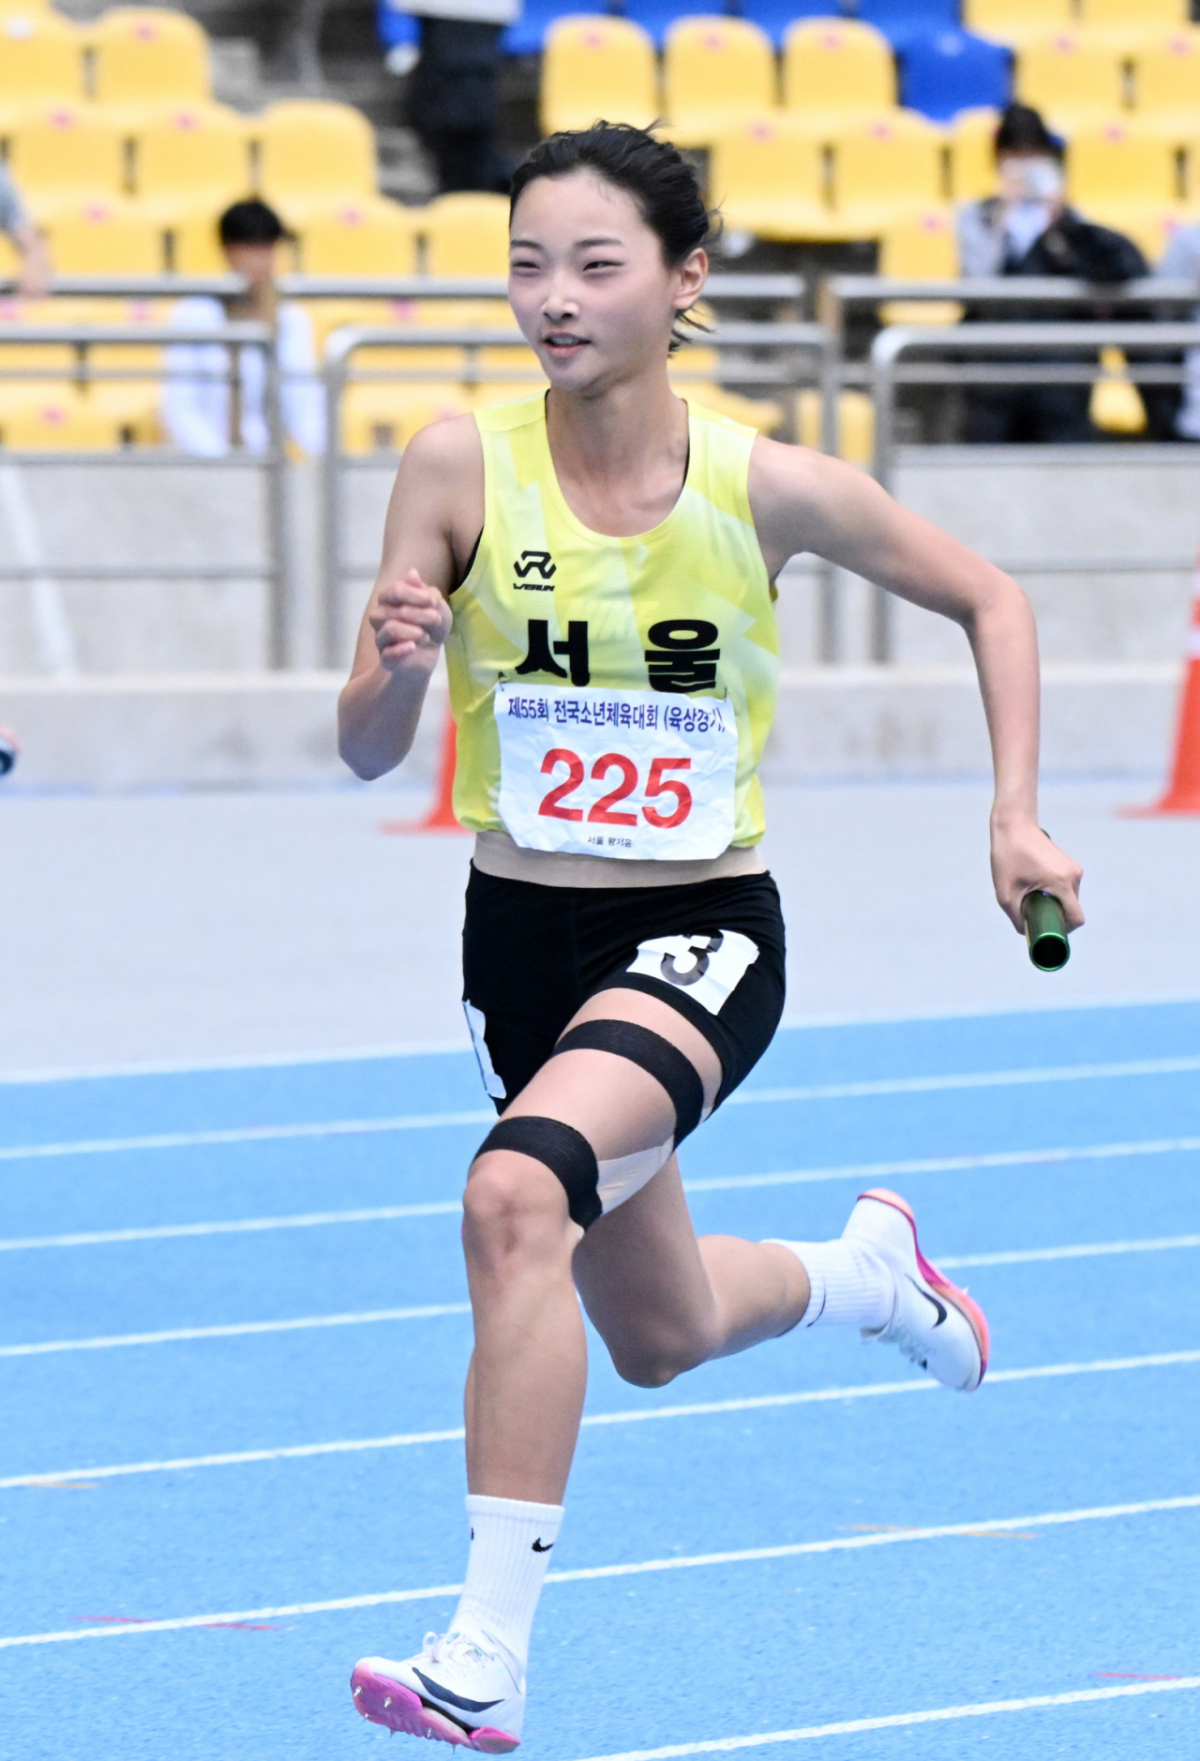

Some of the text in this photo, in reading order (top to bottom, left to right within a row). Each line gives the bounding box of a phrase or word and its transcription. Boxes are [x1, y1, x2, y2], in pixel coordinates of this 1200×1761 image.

[508, 696, 549, 722] 제55회
[554, 699, 658, 730] 전국소년체육대회
[538, 748, 693, 829] 225
[587, 835, 604, 845] 서울
[660, 929, 724, 987] 3
